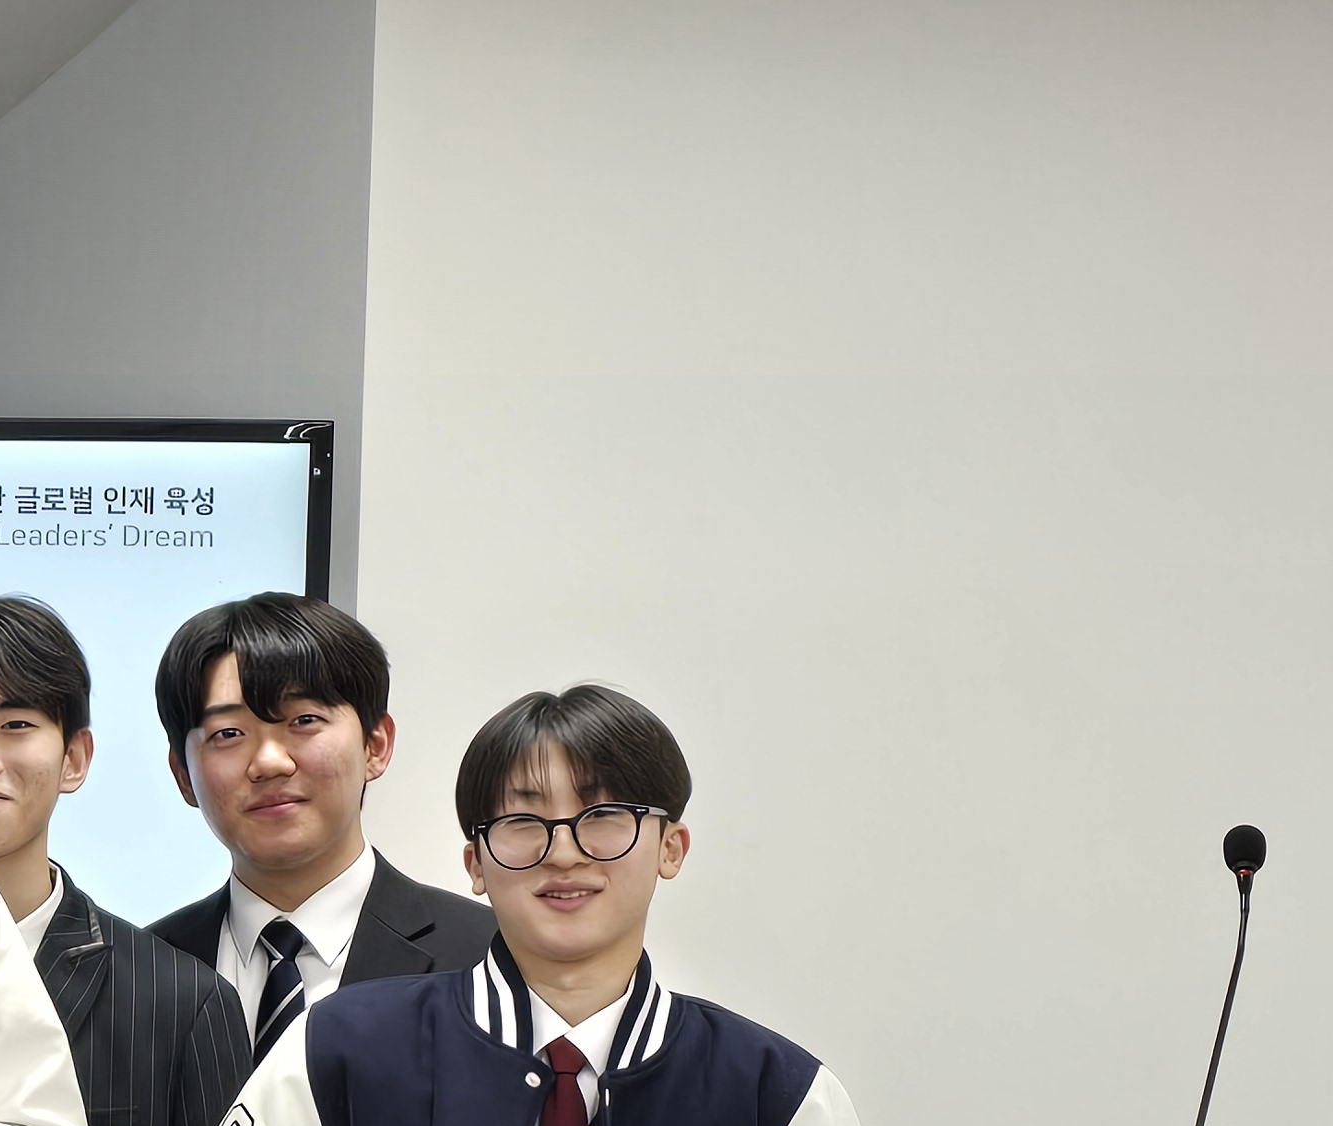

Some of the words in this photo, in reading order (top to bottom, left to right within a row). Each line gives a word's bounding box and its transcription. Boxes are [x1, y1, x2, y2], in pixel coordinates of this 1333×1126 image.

[15, 486, 93, 515] 글로벌
[104, 486, 155, 515] 인재
[164, 487, 215, 516] 육성
[123, 524, 214, 547] Dream
